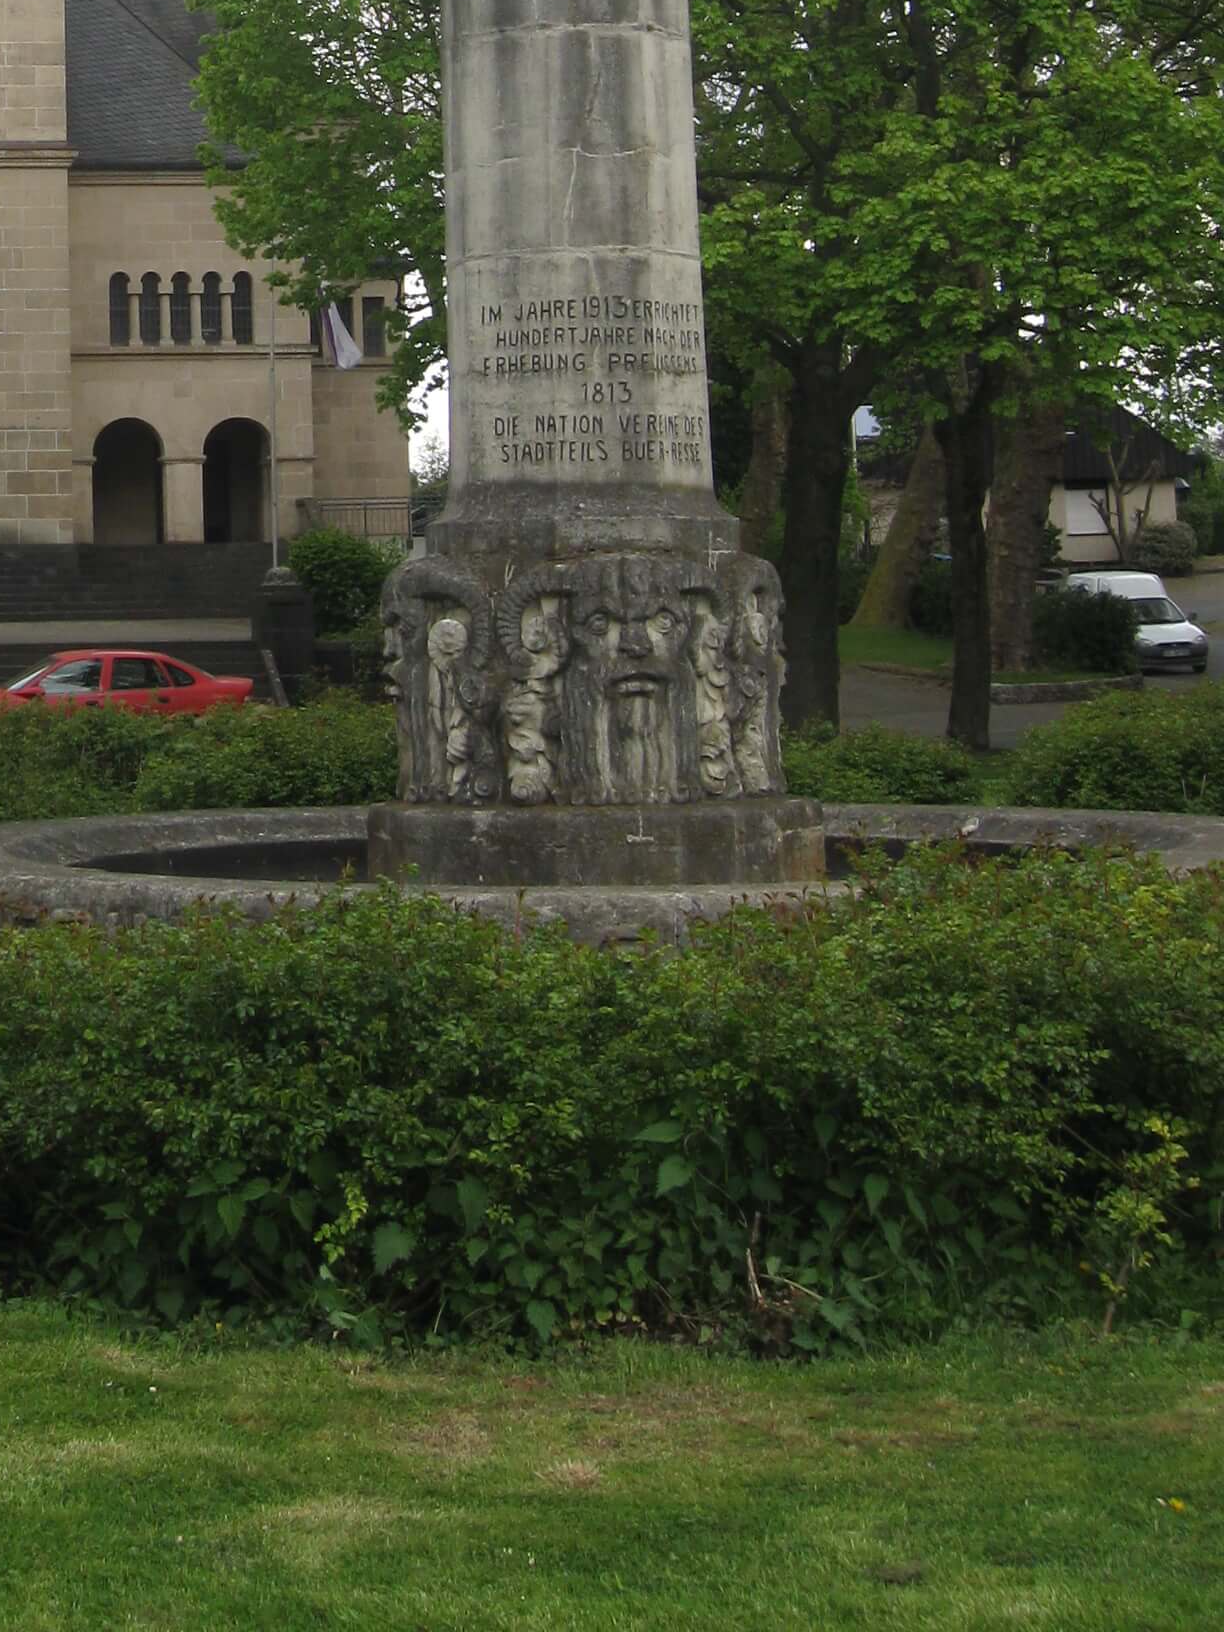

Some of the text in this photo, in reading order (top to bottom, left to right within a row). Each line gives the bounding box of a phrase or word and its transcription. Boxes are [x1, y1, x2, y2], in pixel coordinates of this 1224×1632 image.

[480, 295, 698, 325] IM JAHRE 1913 ERRICHTET
[644, 328, 675, 345] NACH
[680, 330, 700, 349] DER
[483, 353, 586, 377] ERHEBUNG
[582, 381, 632, 404] 1813
[494, 414, 704, 437] DIE NATION VEREINE DES
[501, 439, 609, 464] STADTTEILS
